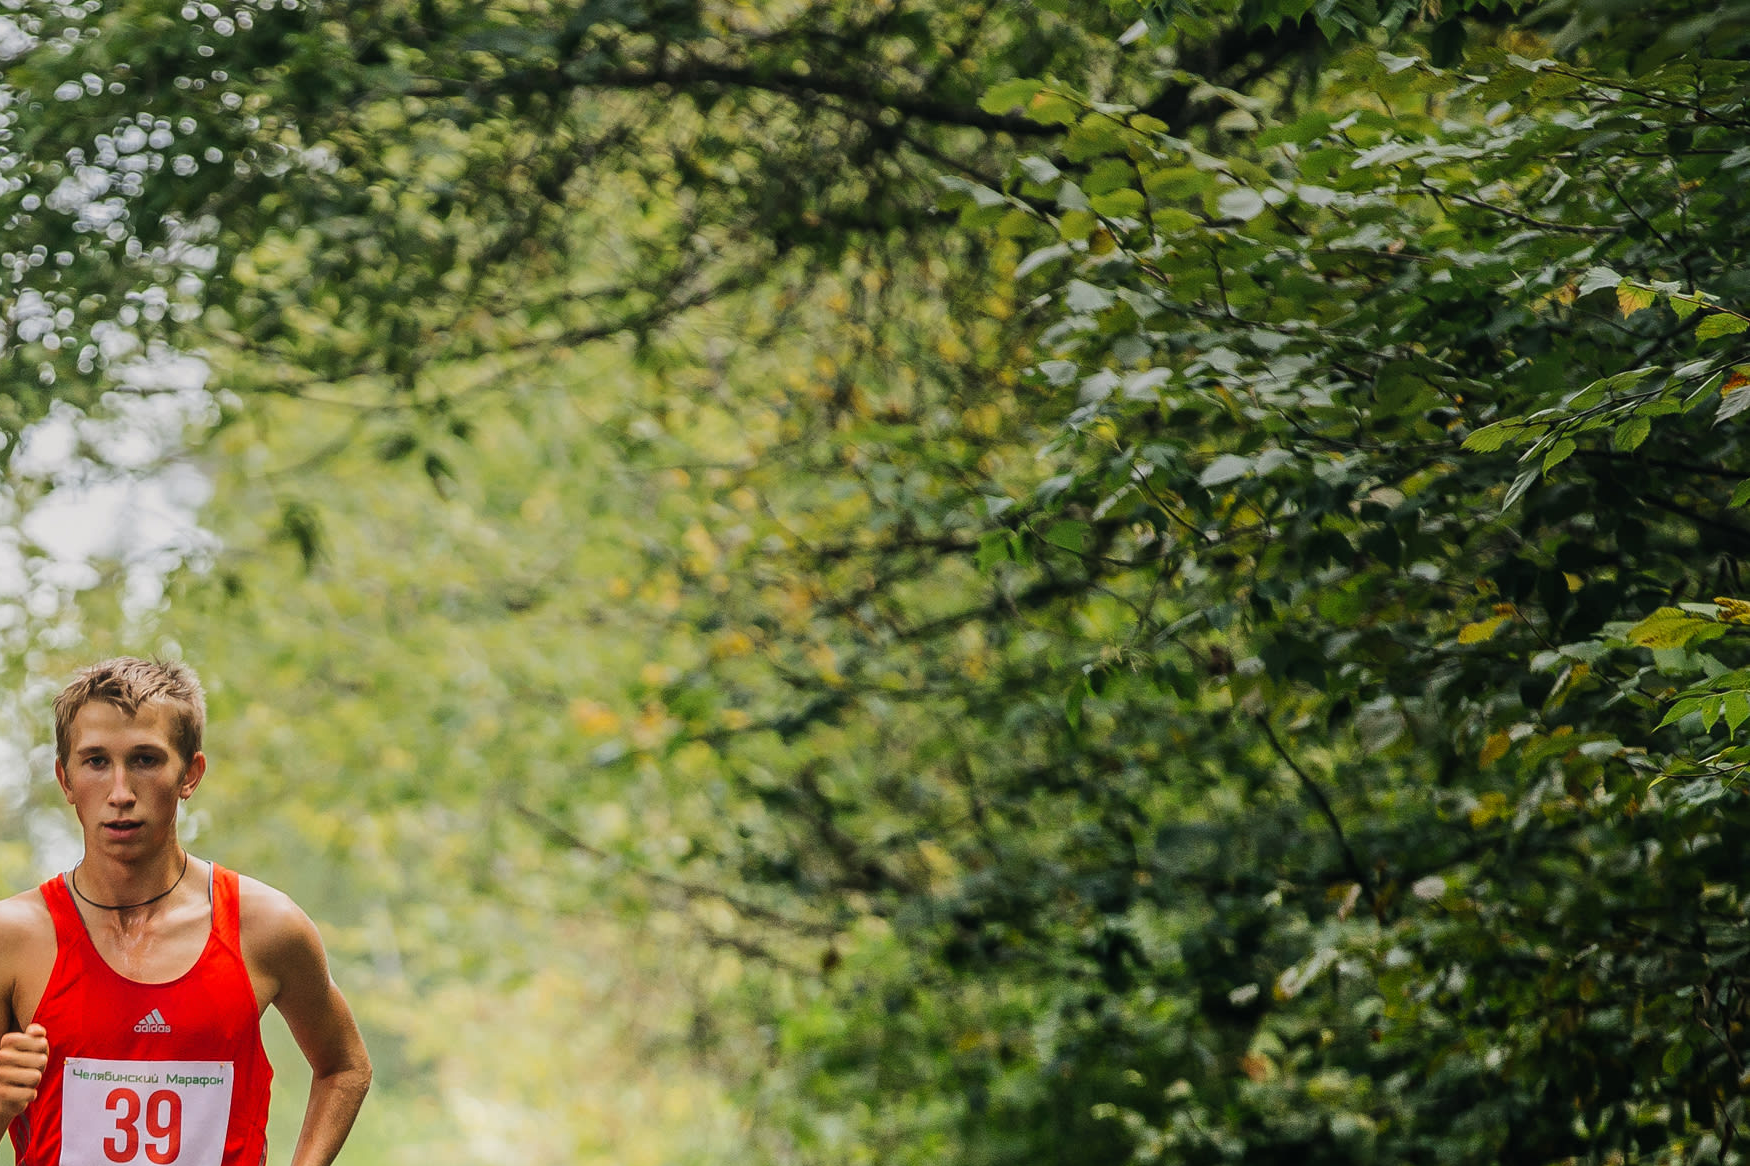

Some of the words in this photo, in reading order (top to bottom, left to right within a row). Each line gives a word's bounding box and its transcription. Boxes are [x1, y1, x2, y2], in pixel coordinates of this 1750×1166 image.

[134, 1023, 171, 1033] adidas
[73, 1069, 159, 1084] Челябинский
[166, 1073, 224, 1088] Марафон
[103, 1087, 182, 1165] 39
